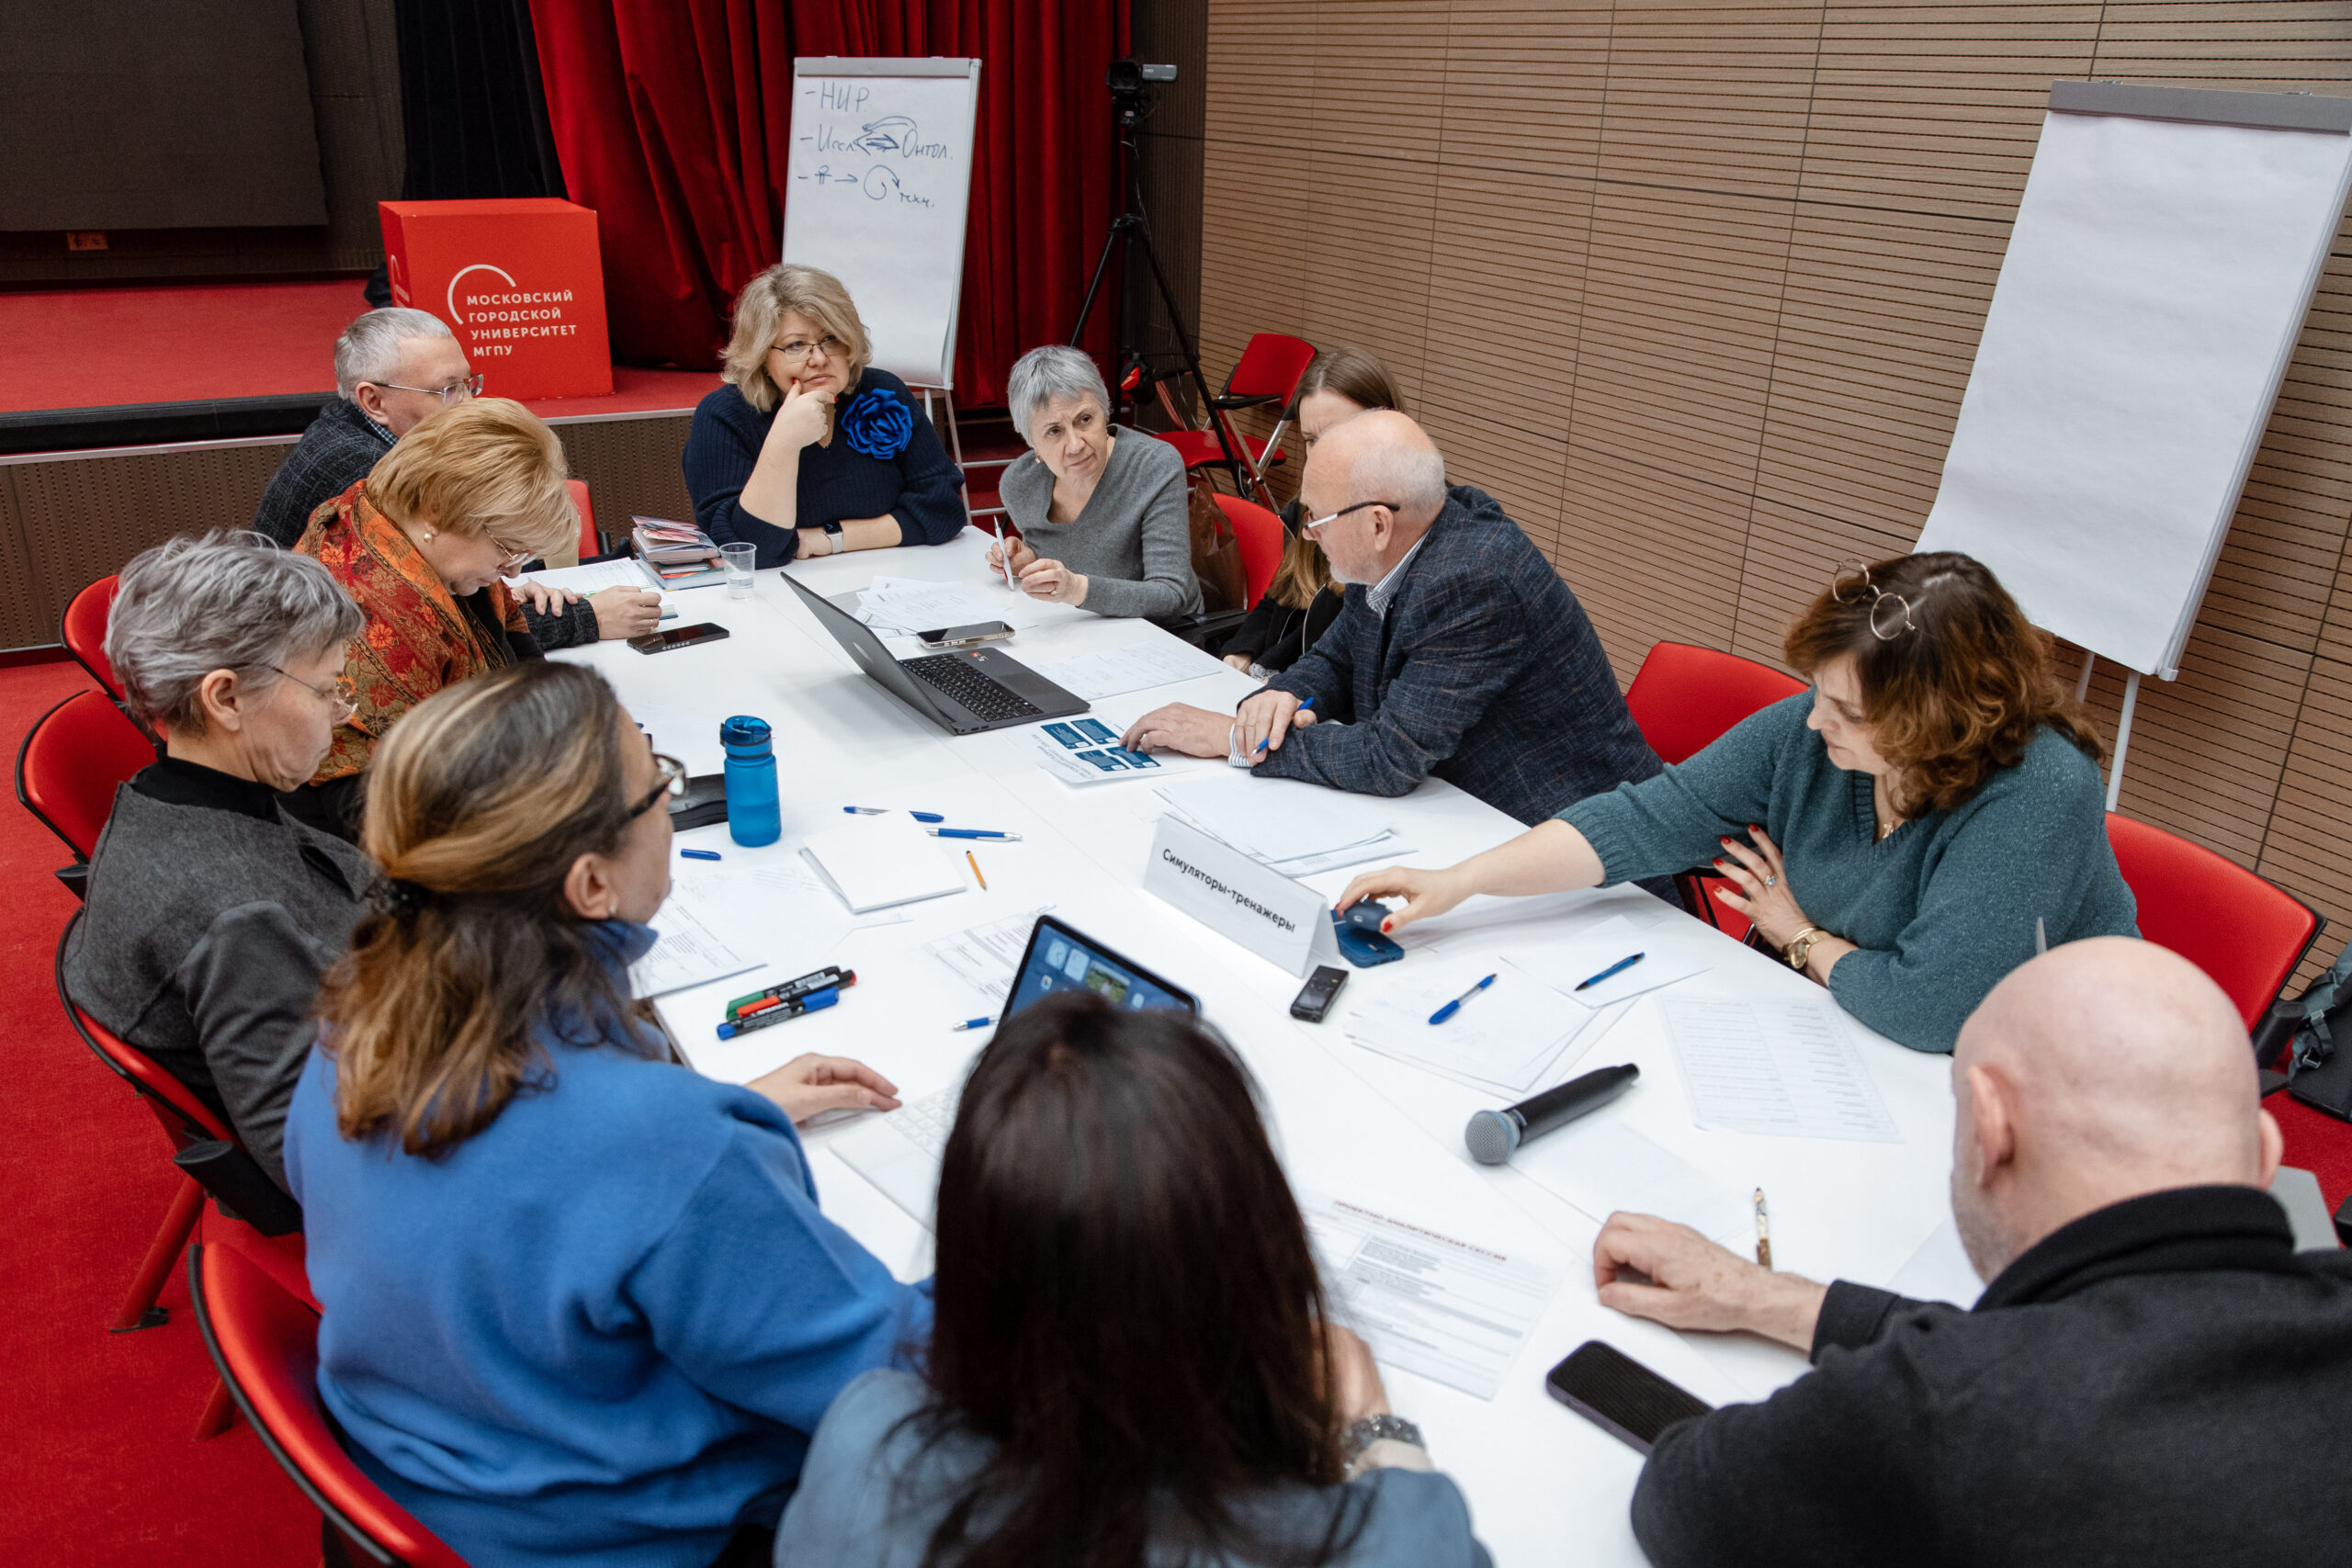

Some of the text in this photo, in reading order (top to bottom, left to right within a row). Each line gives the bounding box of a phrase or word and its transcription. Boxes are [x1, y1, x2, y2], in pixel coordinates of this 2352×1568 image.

[467, 288, 573, 306] МОСКОВСКИЙ
[469, 307, 561, 323] ГОРОДСКОЙ
[469, 324, 577, 341] УНИВЕРСИТЕТ
[473, 344, 513, 357] МГПУ
[1162, 848, 1296, 933] Симуляторы-тренажеры
